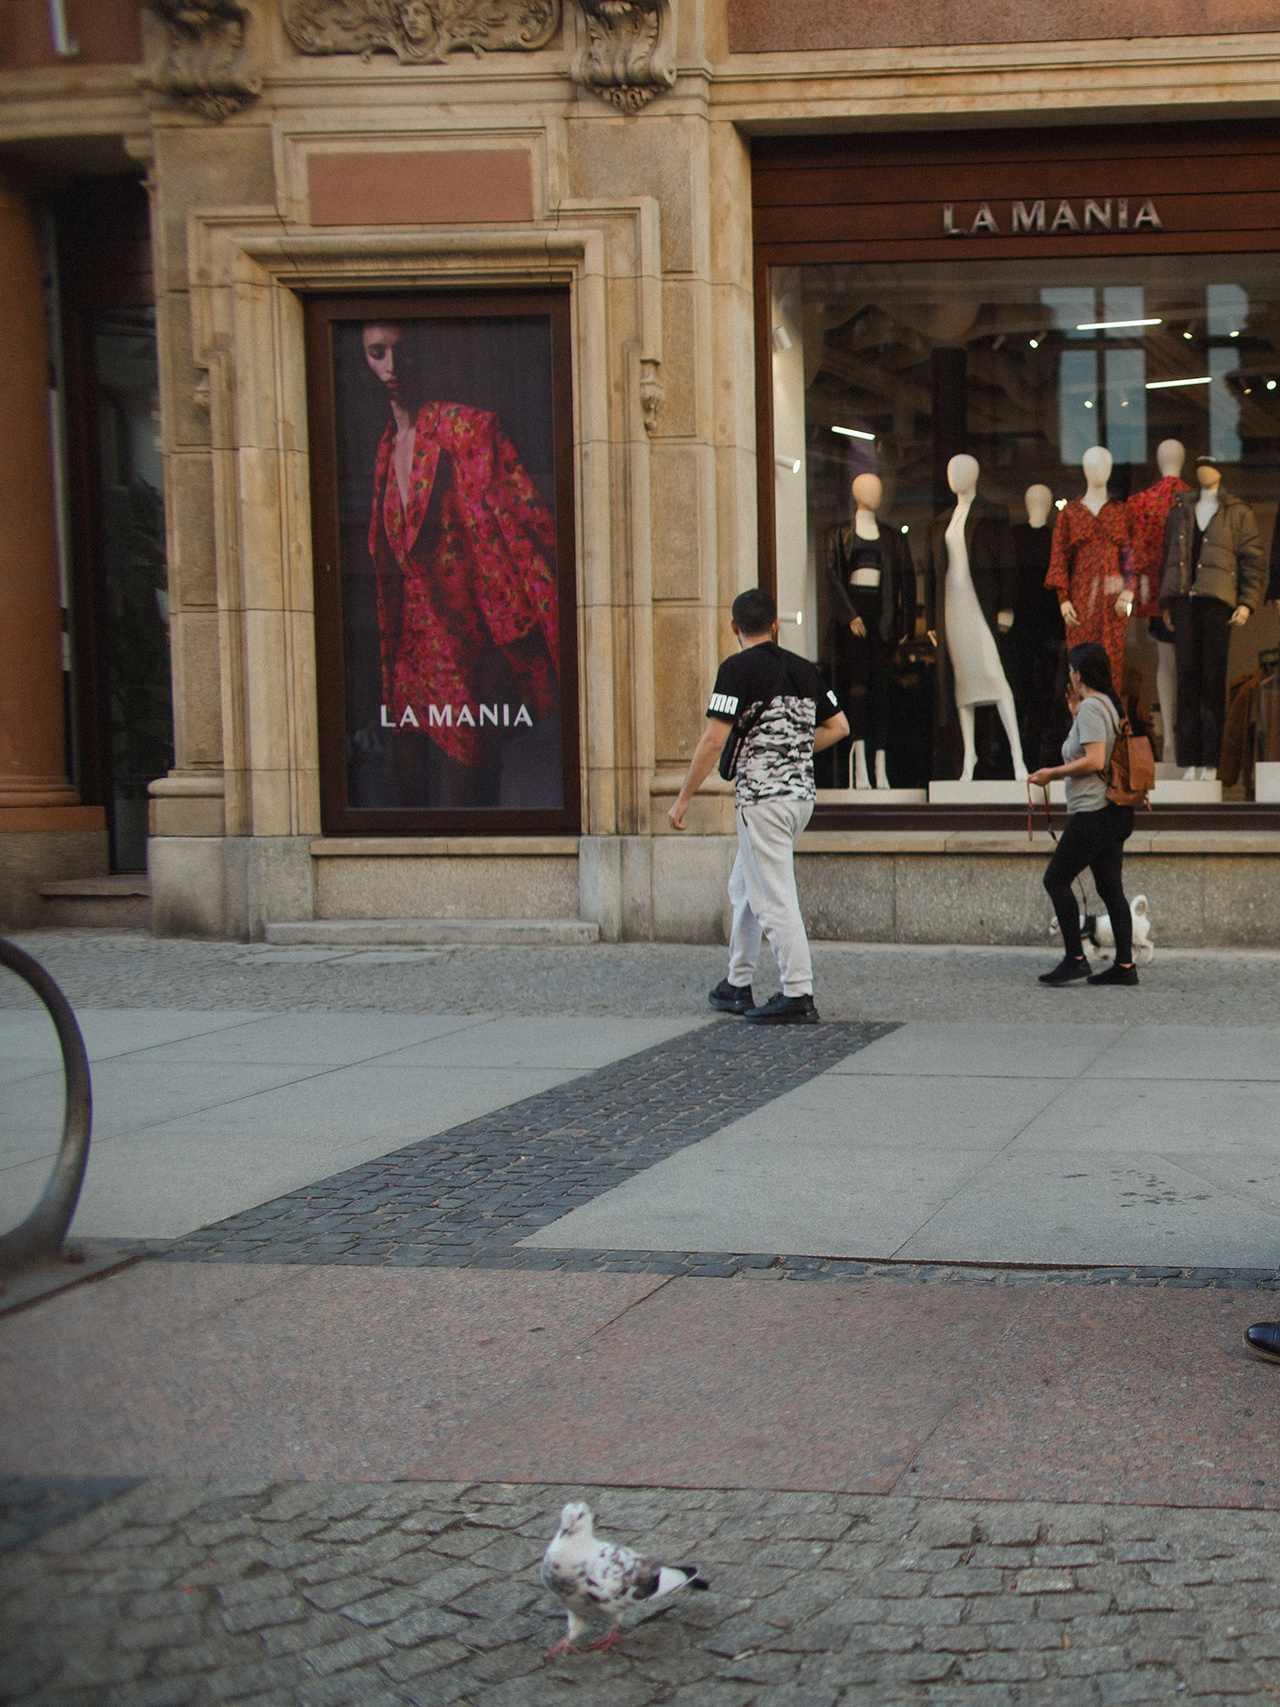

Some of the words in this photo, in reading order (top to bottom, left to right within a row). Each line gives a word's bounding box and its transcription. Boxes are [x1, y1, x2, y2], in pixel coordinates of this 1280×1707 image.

[943, 203, 999, 235] LA
[1011, 198, 1163, 232] MANIA
[380, 704, 419, 727] LA
[428, 703, 533, 727] MANIA
